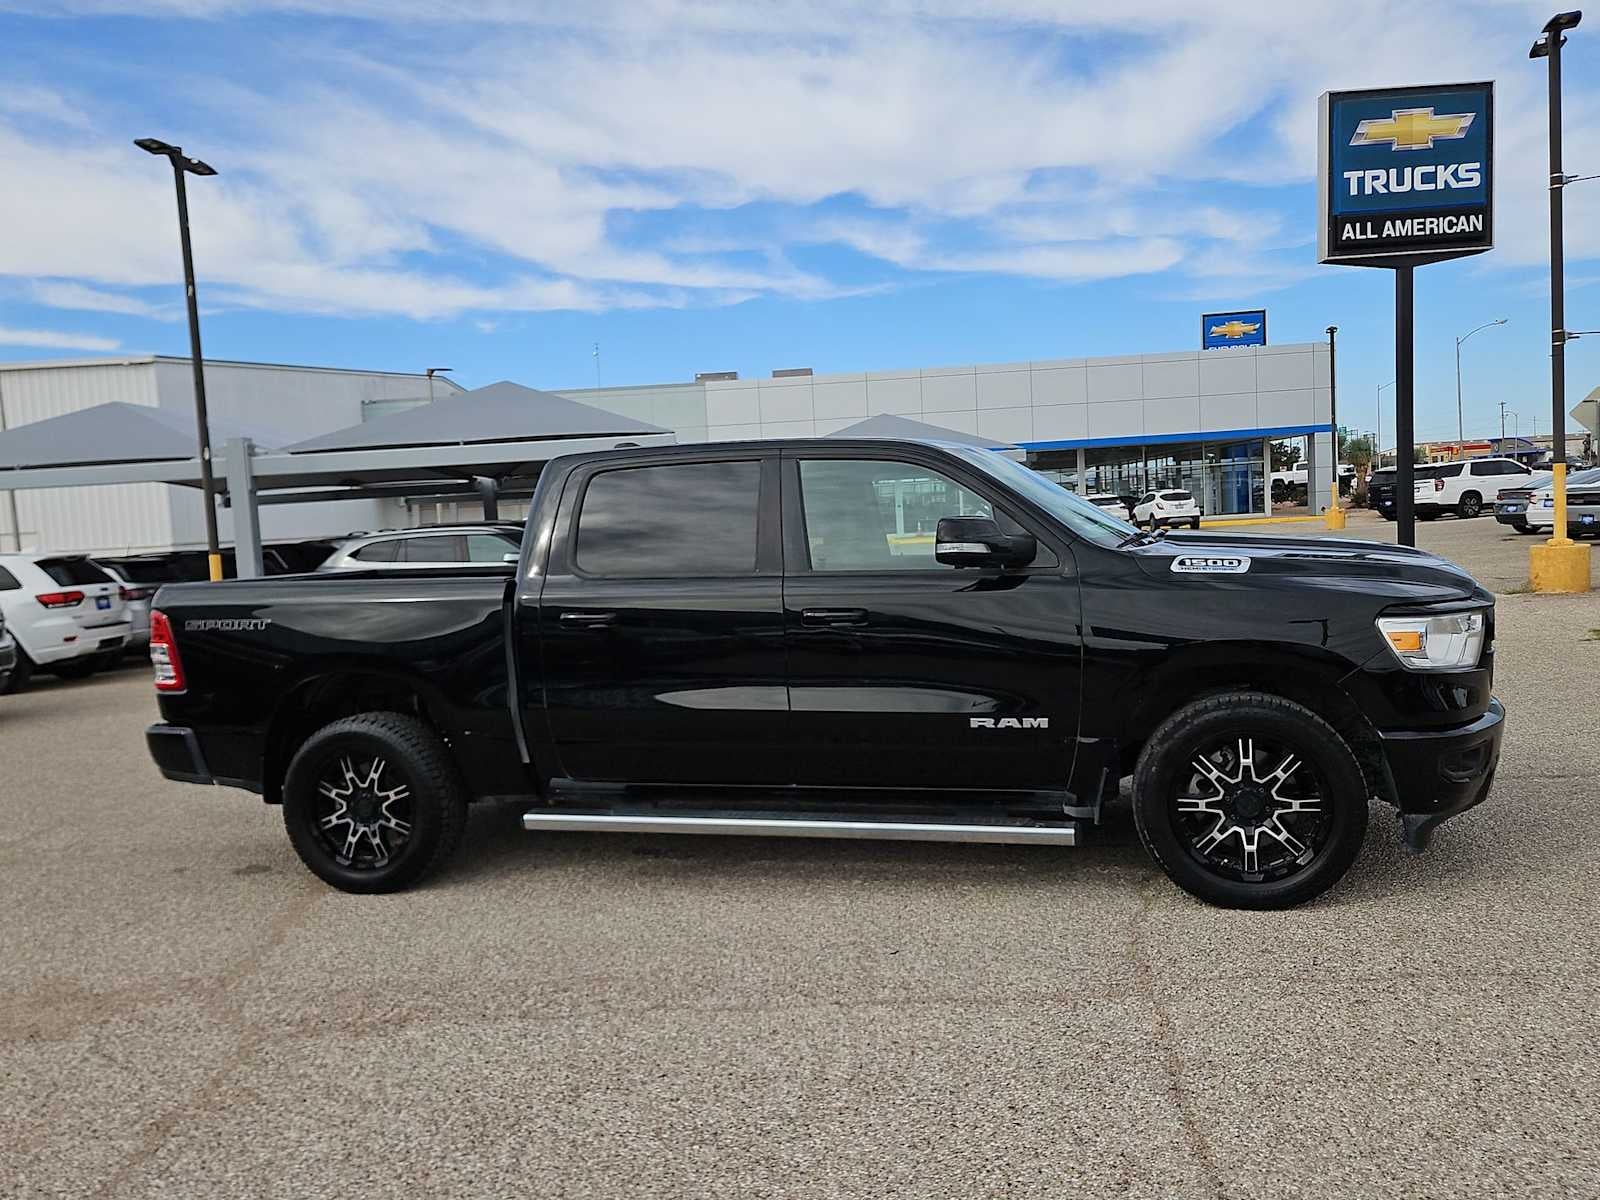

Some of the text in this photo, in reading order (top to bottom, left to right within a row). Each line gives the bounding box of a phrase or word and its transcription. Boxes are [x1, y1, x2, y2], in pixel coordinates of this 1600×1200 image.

[1343, 162, 1481, 196] TRUCKS
[1341, 214, 1483, 241] ALL AMERICAN
[1183, 559, 1239, 567] 1500
[185, 619, 272, 631] SPORT
[970, 717, 1049, 728] RAM
